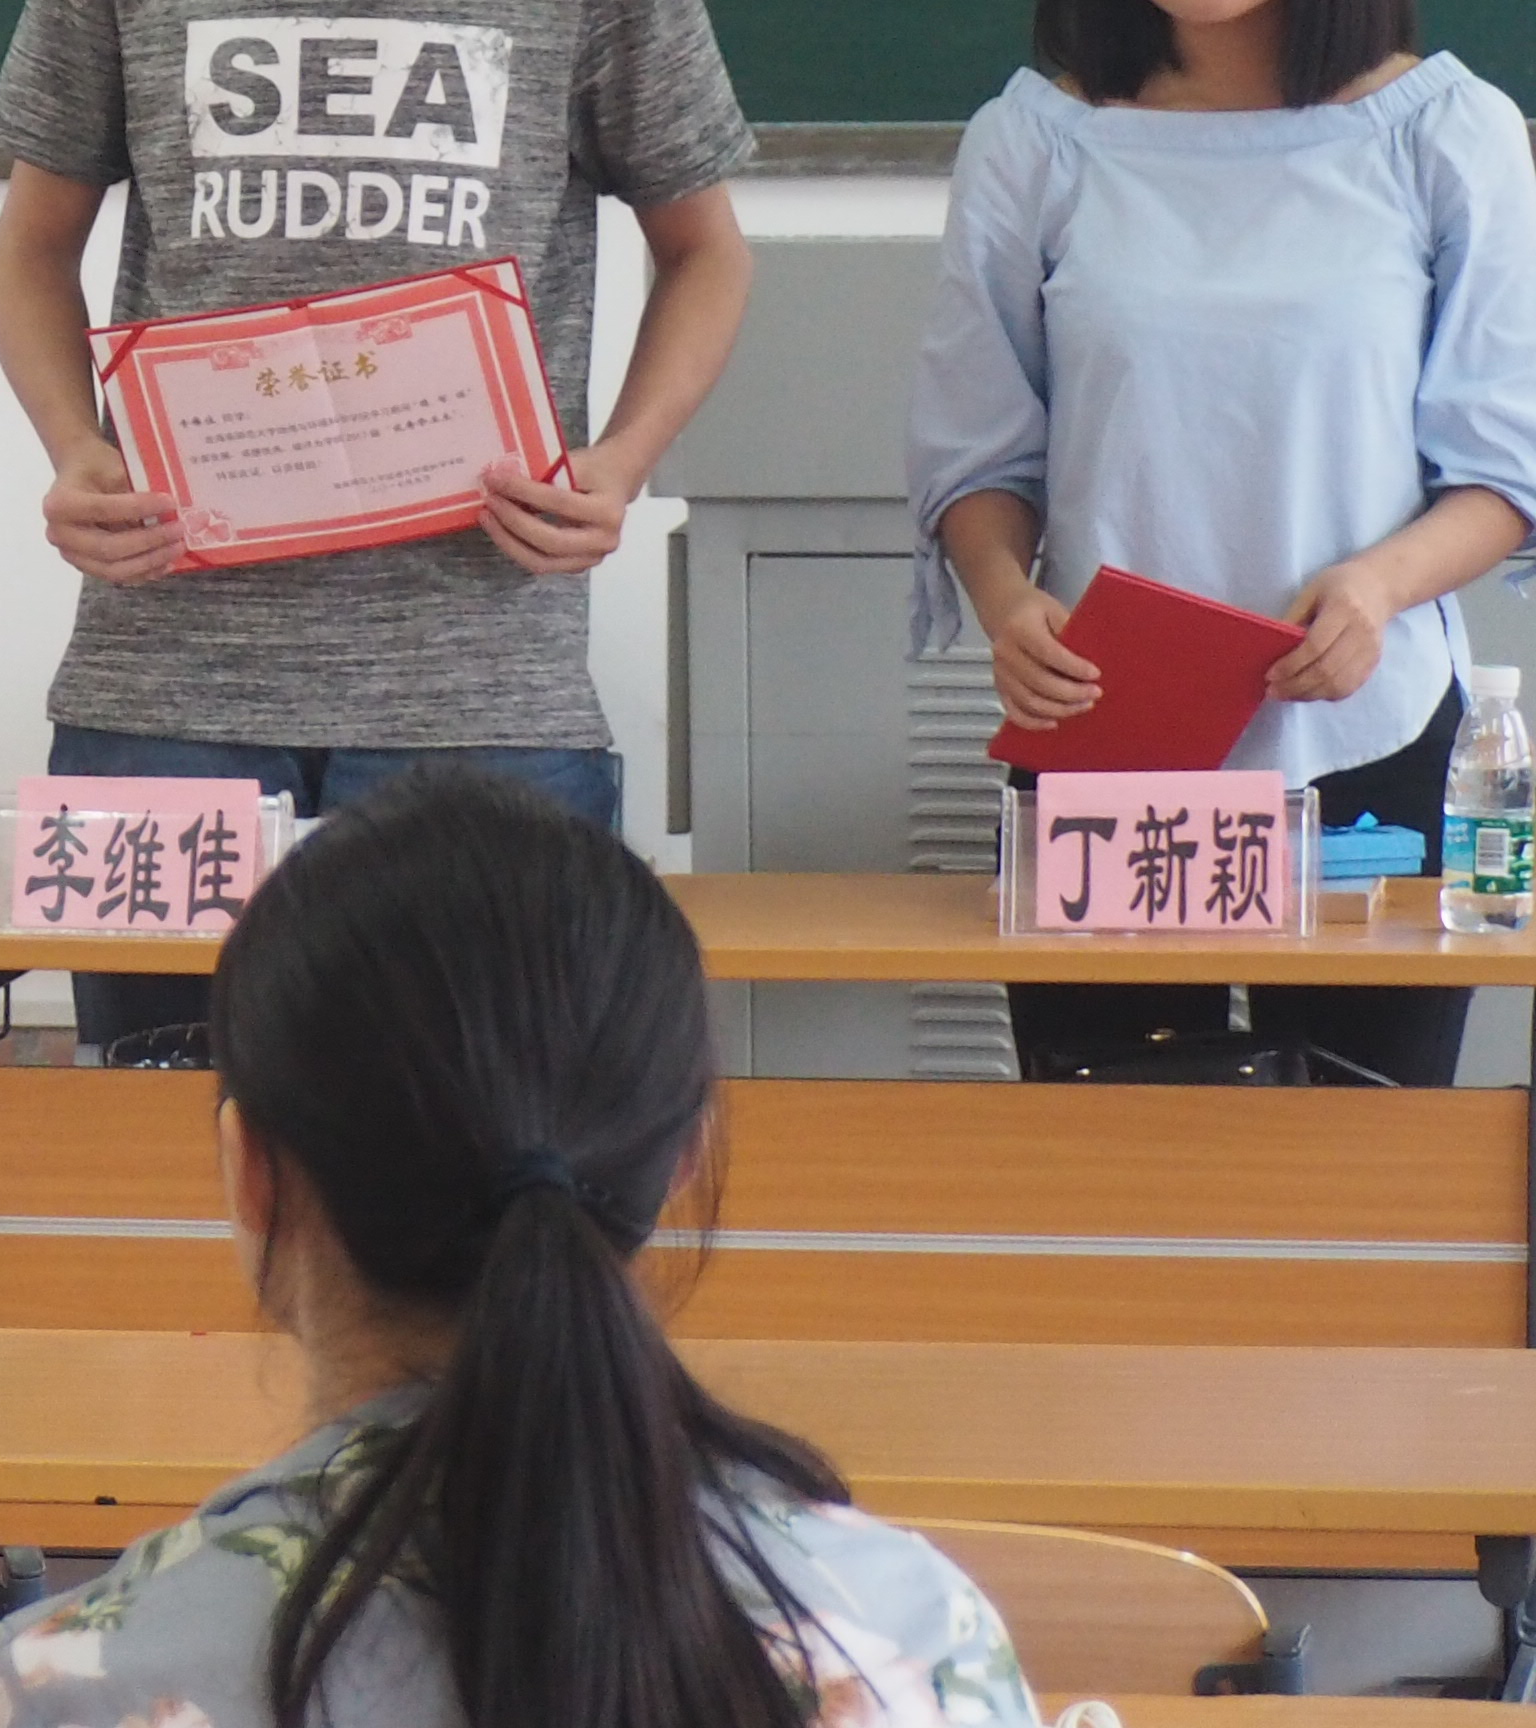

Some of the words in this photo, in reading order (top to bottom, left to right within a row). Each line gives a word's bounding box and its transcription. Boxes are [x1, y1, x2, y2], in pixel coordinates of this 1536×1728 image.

[208, 36, 478, 145] SEA
[190, 169, 492, 250] RUDDER
[255, 351, 378, 398] 荣誉证书
[24, 803, 246, 926] 李维佳
[1048, 803, 1276, 926] 丁新颖
